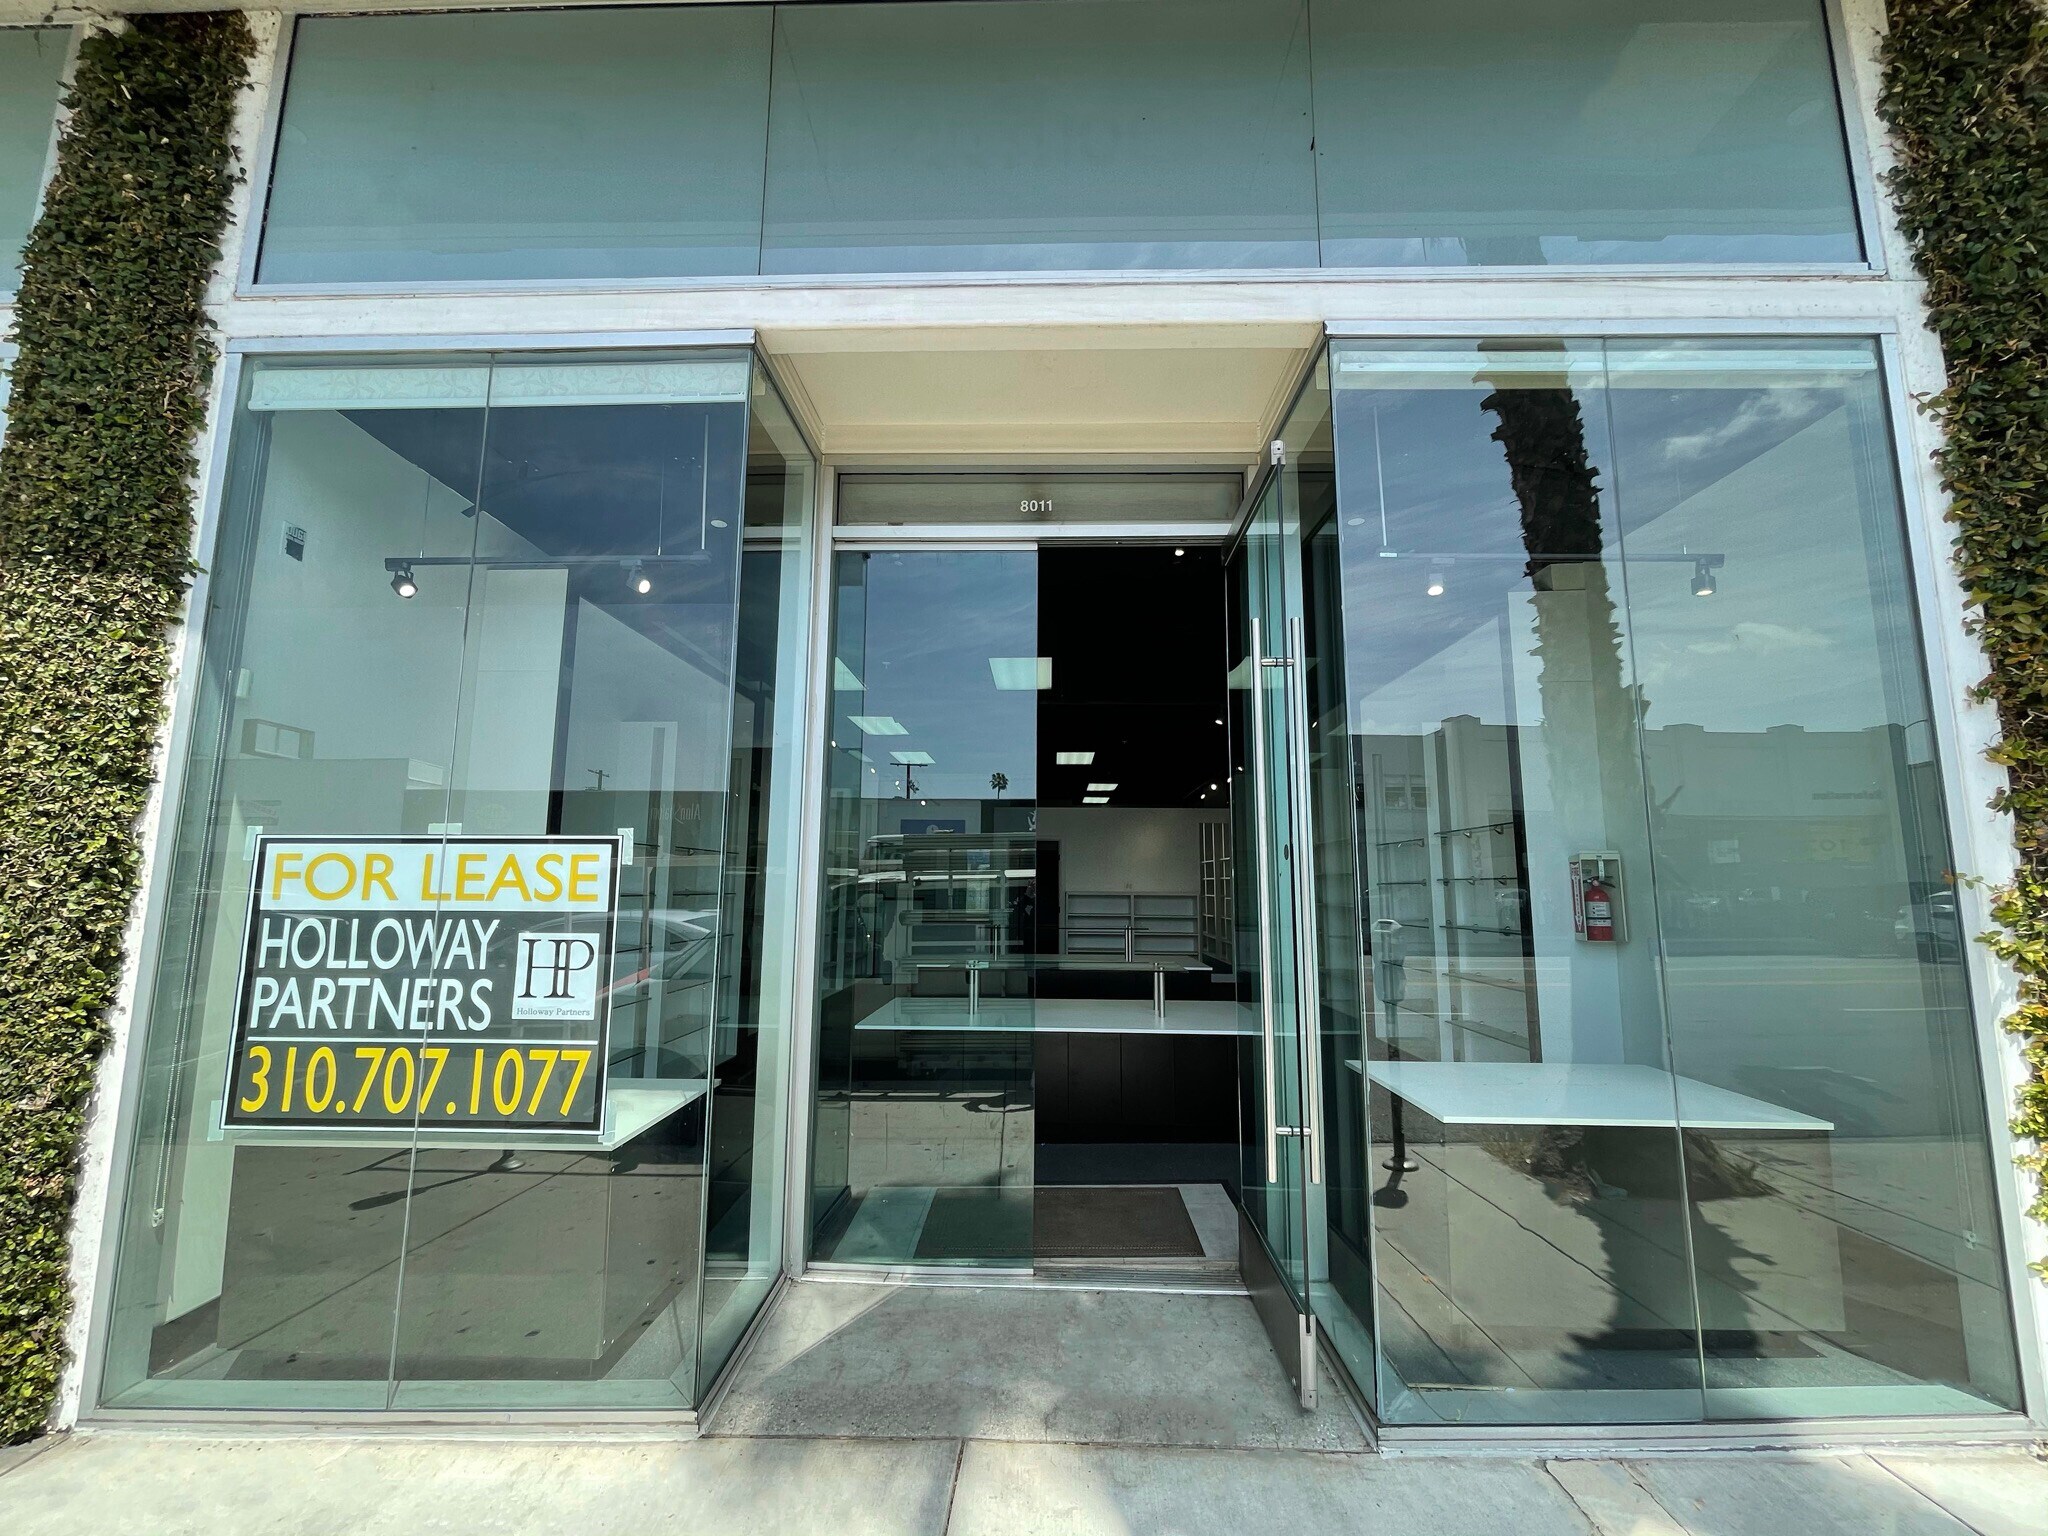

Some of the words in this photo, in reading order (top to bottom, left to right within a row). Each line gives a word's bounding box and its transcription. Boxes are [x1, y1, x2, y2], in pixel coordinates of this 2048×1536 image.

[1020, 500, 1053, 512] 8011
[271, 852, 398, 902] FOR
[421, 853, 601, 903] LEASE
[257, 917, 500, 971] HOLLOWAY
[517, 938, 595, 999] HP
[250, 977, 493, 1031] PARTNERS
[516, 1007, 555, 1017] Holloway
[556, 1008, 591, 1016] Partners
[240, 1045, 593, 1117] 310.707.1077
